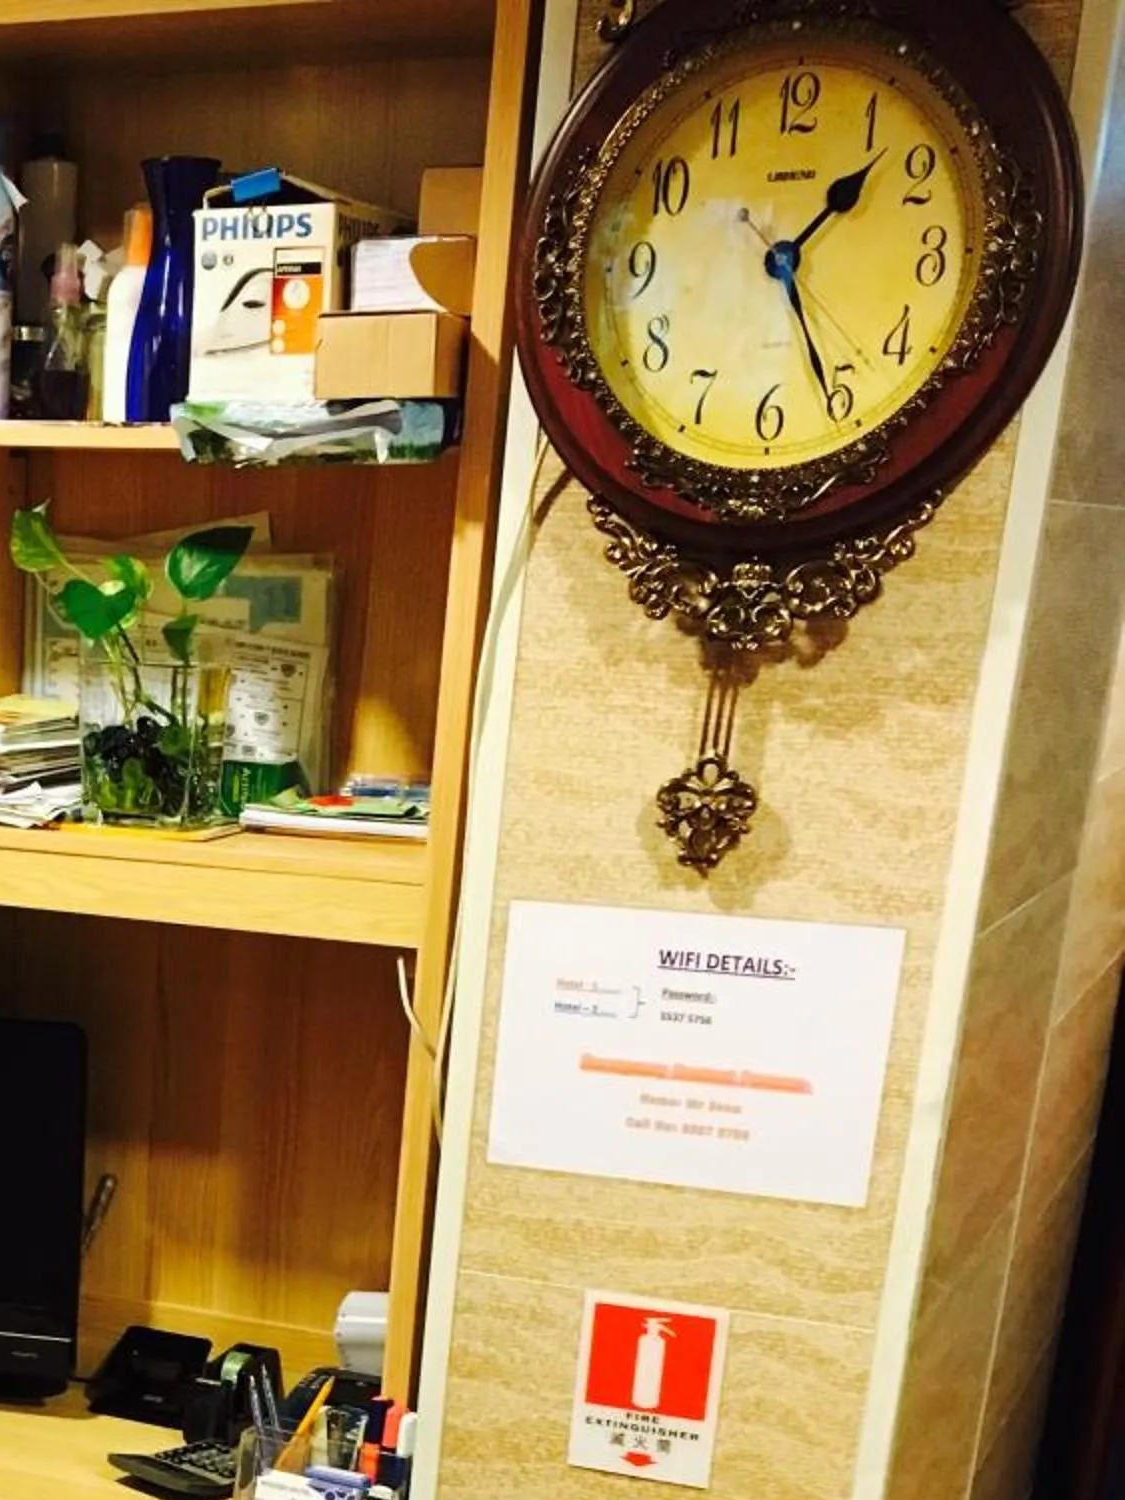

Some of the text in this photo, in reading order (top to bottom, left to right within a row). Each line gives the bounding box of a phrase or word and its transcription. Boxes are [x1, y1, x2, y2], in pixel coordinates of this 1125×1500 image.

[710, 98, 741, 159] 11
[779, 72, 821, 136] 12
[865, 92, 878, 152] 1
[652, 156, 690, 216] 10
[902, 143, 936, 206] 2
[202, 213, 313, 241] PHILIPS
[916, 225, 948, 287] 3
[629, 241, 656, 299] 9
[642, 315, 670, 373] 8
[882, 304, 912, 366] 4
[690, 369, 718, 425] 7
[755, 383, 784, 441] 6
[827, 364, 854, 423] 5
[659, 949, 701, 968] WIFI
[585, 1416, 700, 1441] EXTINGUISHER
